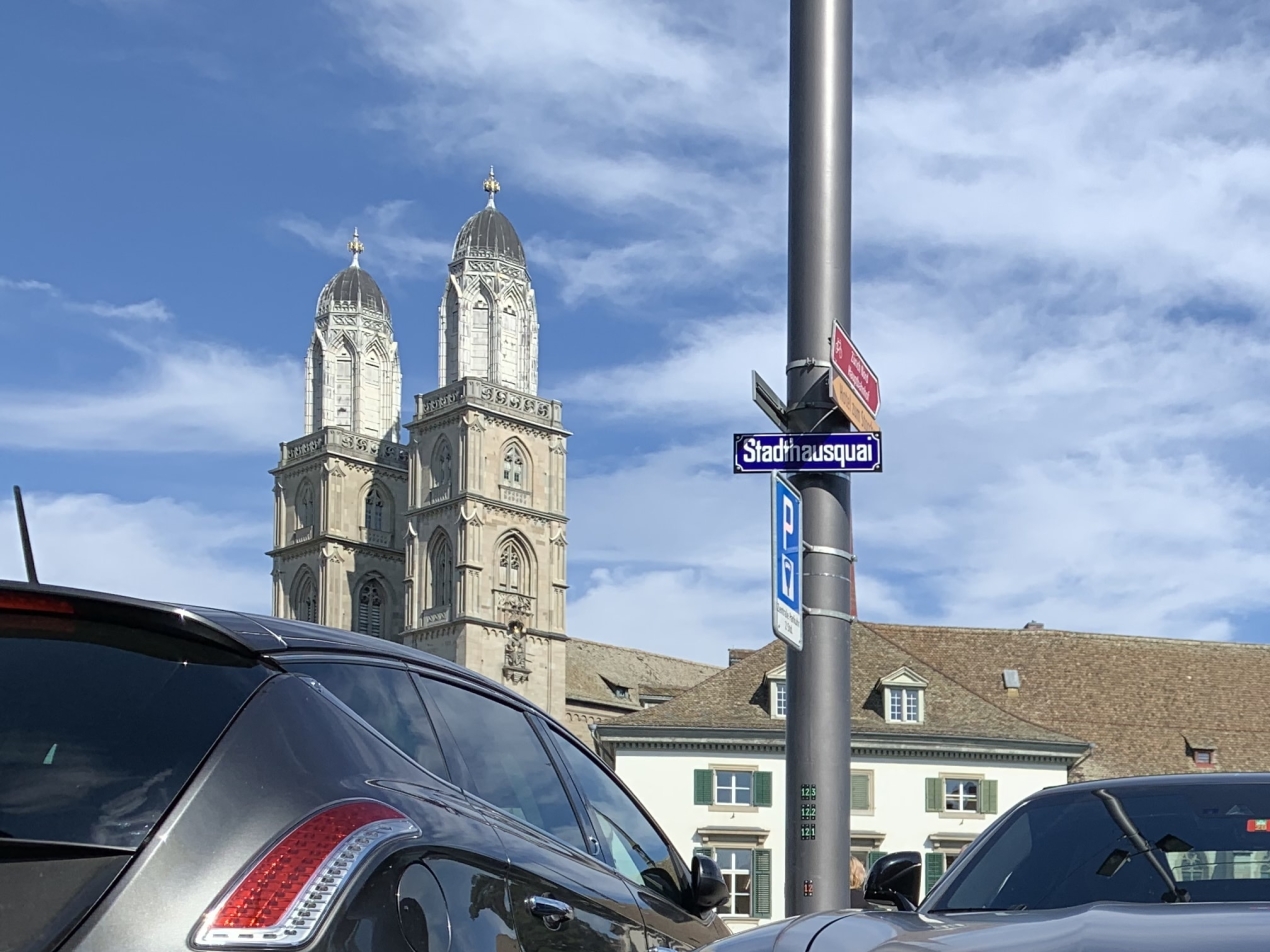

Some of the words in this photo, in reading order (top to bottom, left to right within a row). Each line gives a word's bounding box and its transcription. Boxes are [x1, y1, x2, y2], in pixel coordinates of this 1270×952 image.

[743, 436, 873, 468] Stadthausquai
[783, 494, 794, 550] P
[804, 884, 813, 892] 12
